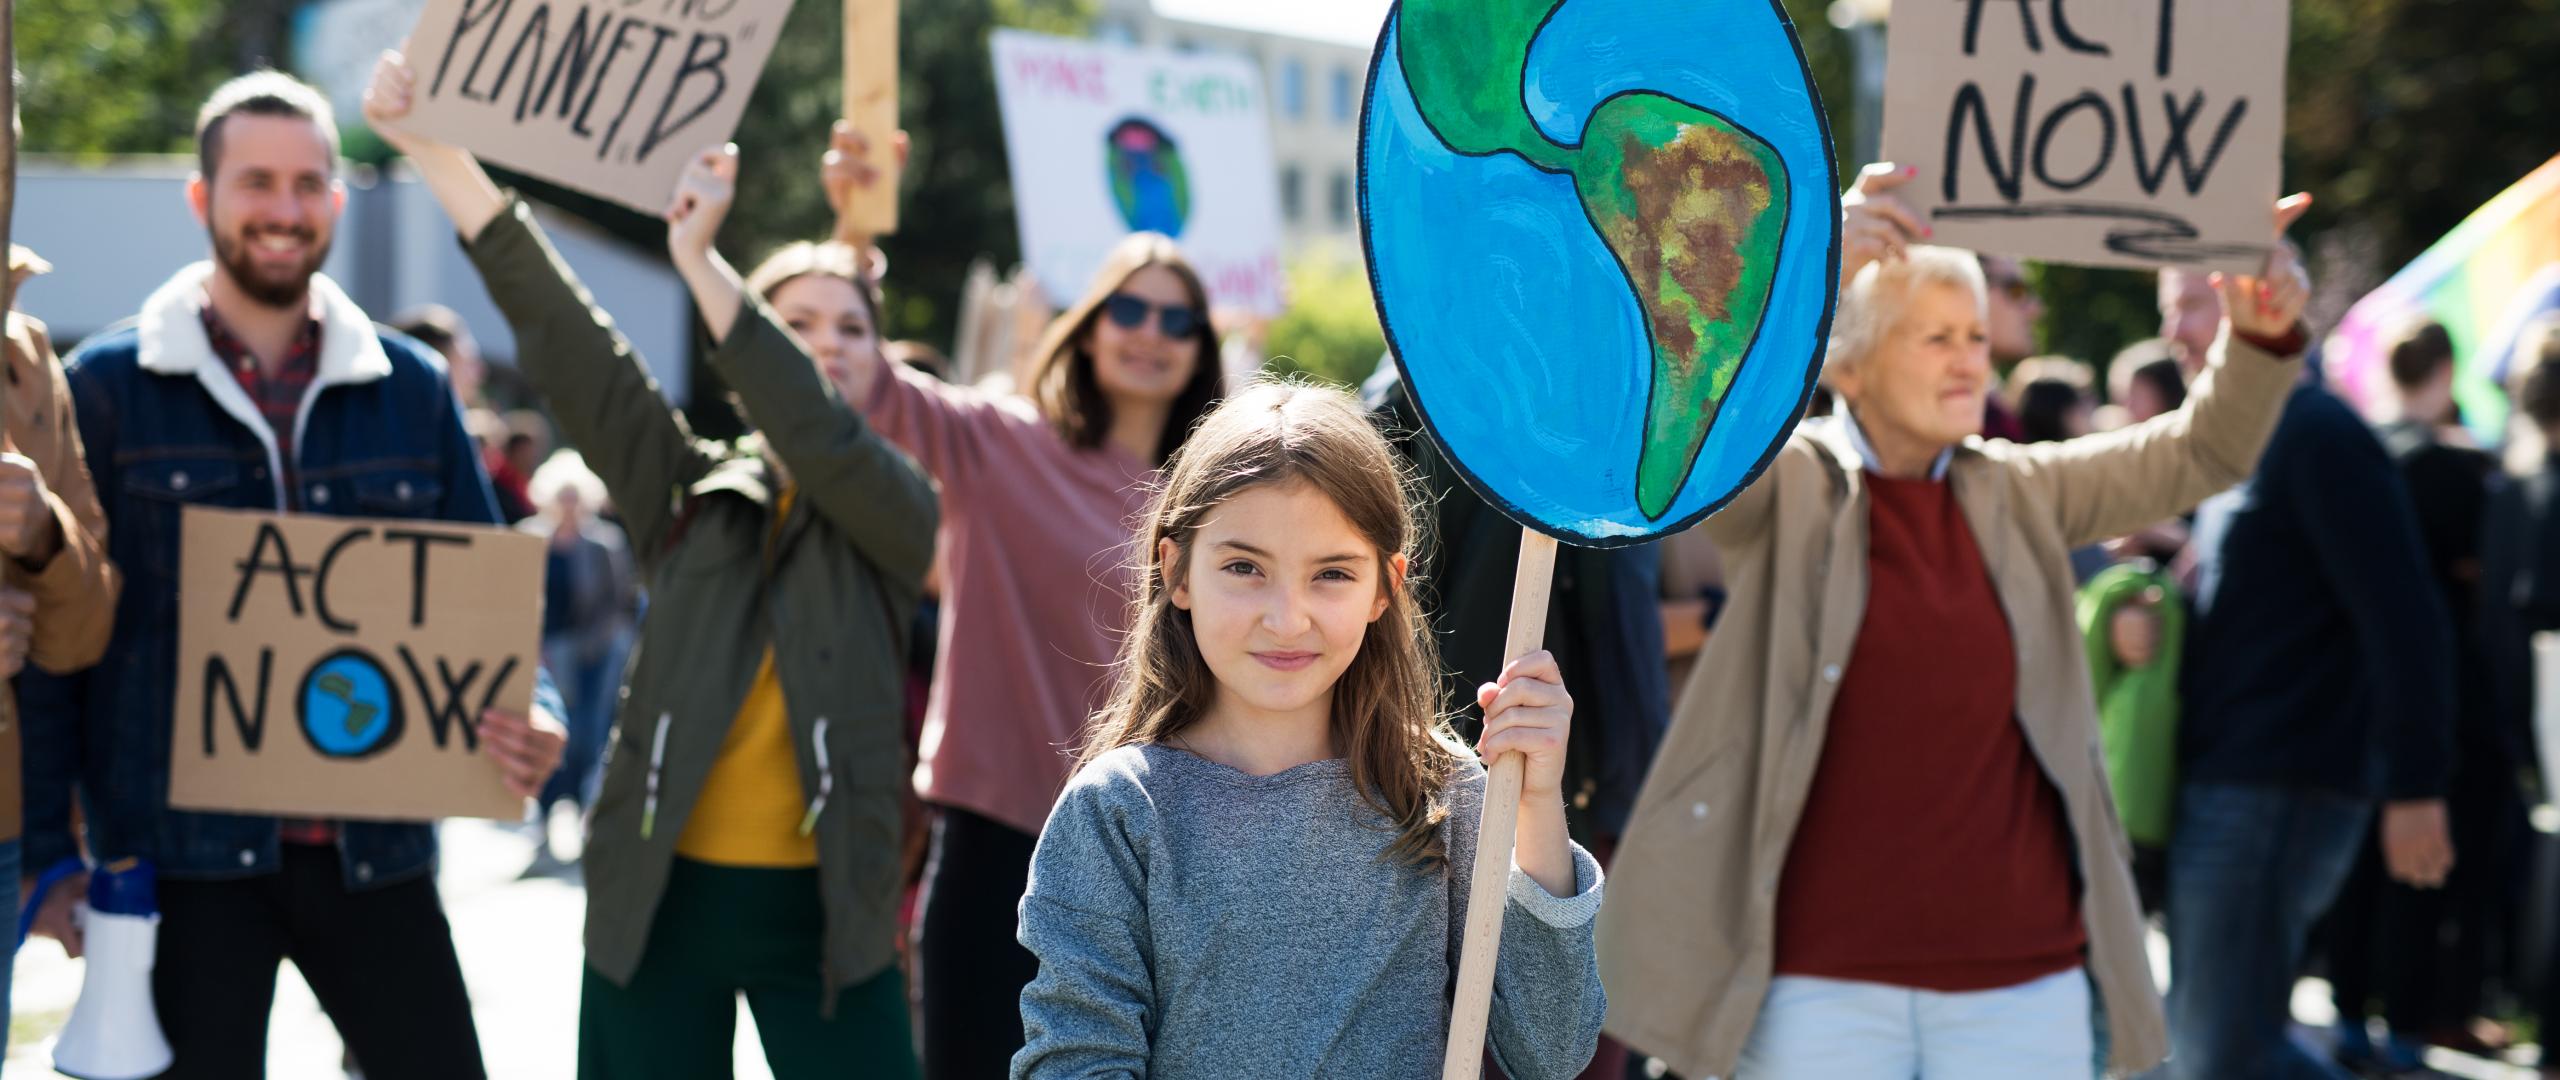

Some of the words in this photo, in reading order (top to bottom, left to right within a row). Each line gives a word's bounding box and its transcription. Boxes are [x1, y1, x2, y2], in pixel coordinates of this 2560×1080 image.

[428, 0, 679, 160] PLANET
[1942, 72, 2249, 203] NOW
[227, 521, 472, 635] ACT
[204, 645, 519, 760] NOW
